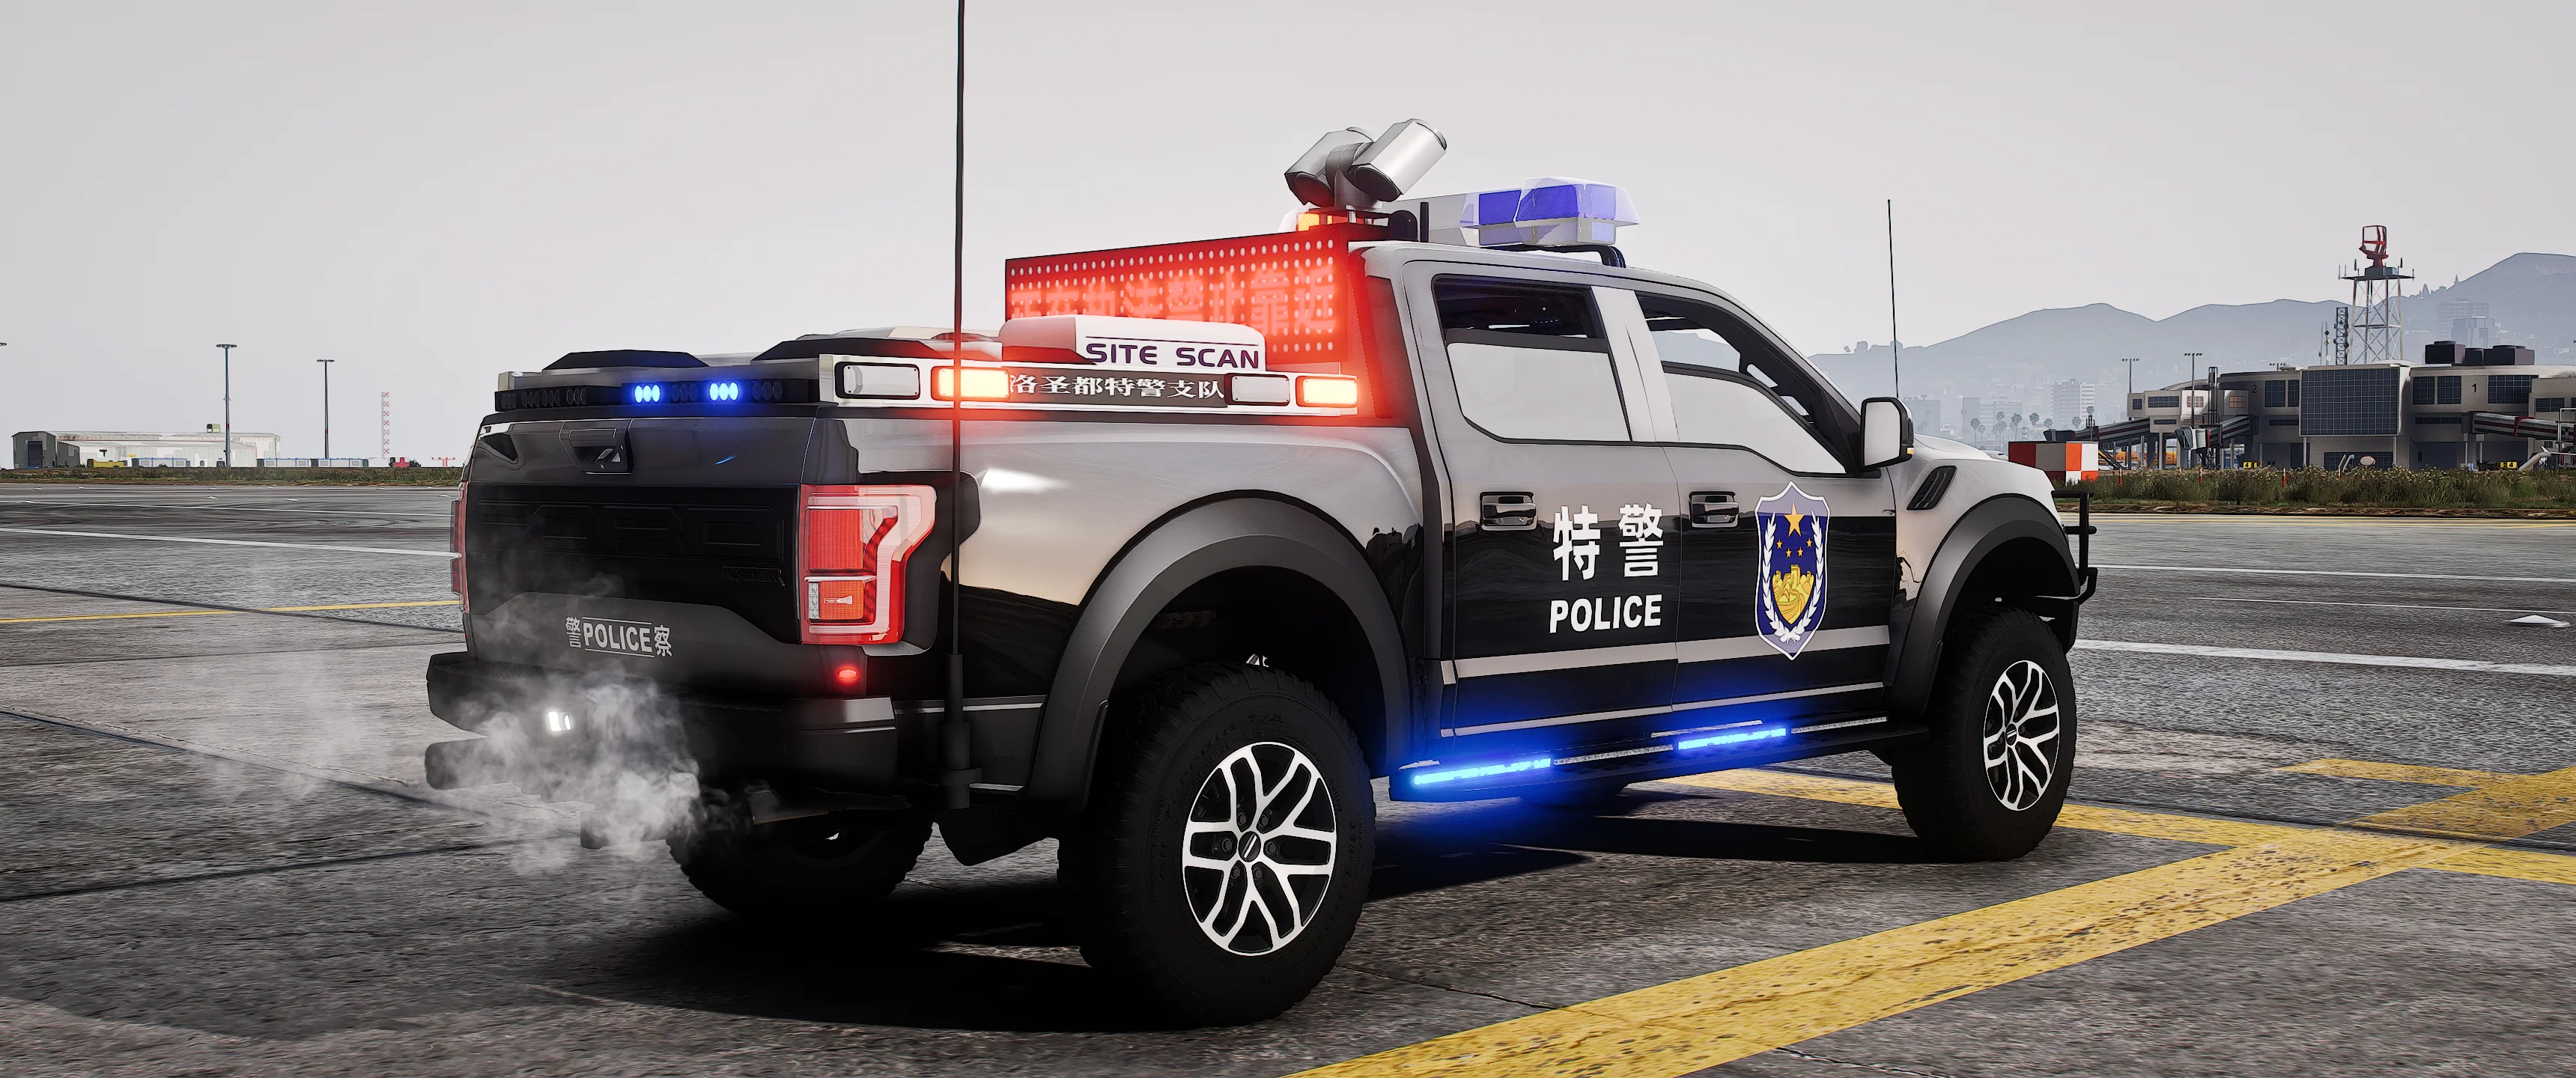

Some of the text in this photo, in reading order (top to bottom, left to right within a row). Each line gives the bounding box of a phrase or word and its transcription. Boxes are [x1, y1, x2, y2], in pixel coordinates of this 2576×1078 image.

[1086, 343, 1259, 369] SITE SCAN
[1010, 374, 1225, 399] 洛圣都特警支队
[2252, 384, 2258, 394] 2
[2471, 383, 2477, 393] 1
[1552, 502, 1664, 582] 特警
[1549, 594, 1662, 633] POLICE
[565, 616, 673, 657] 警 POLICE 察
